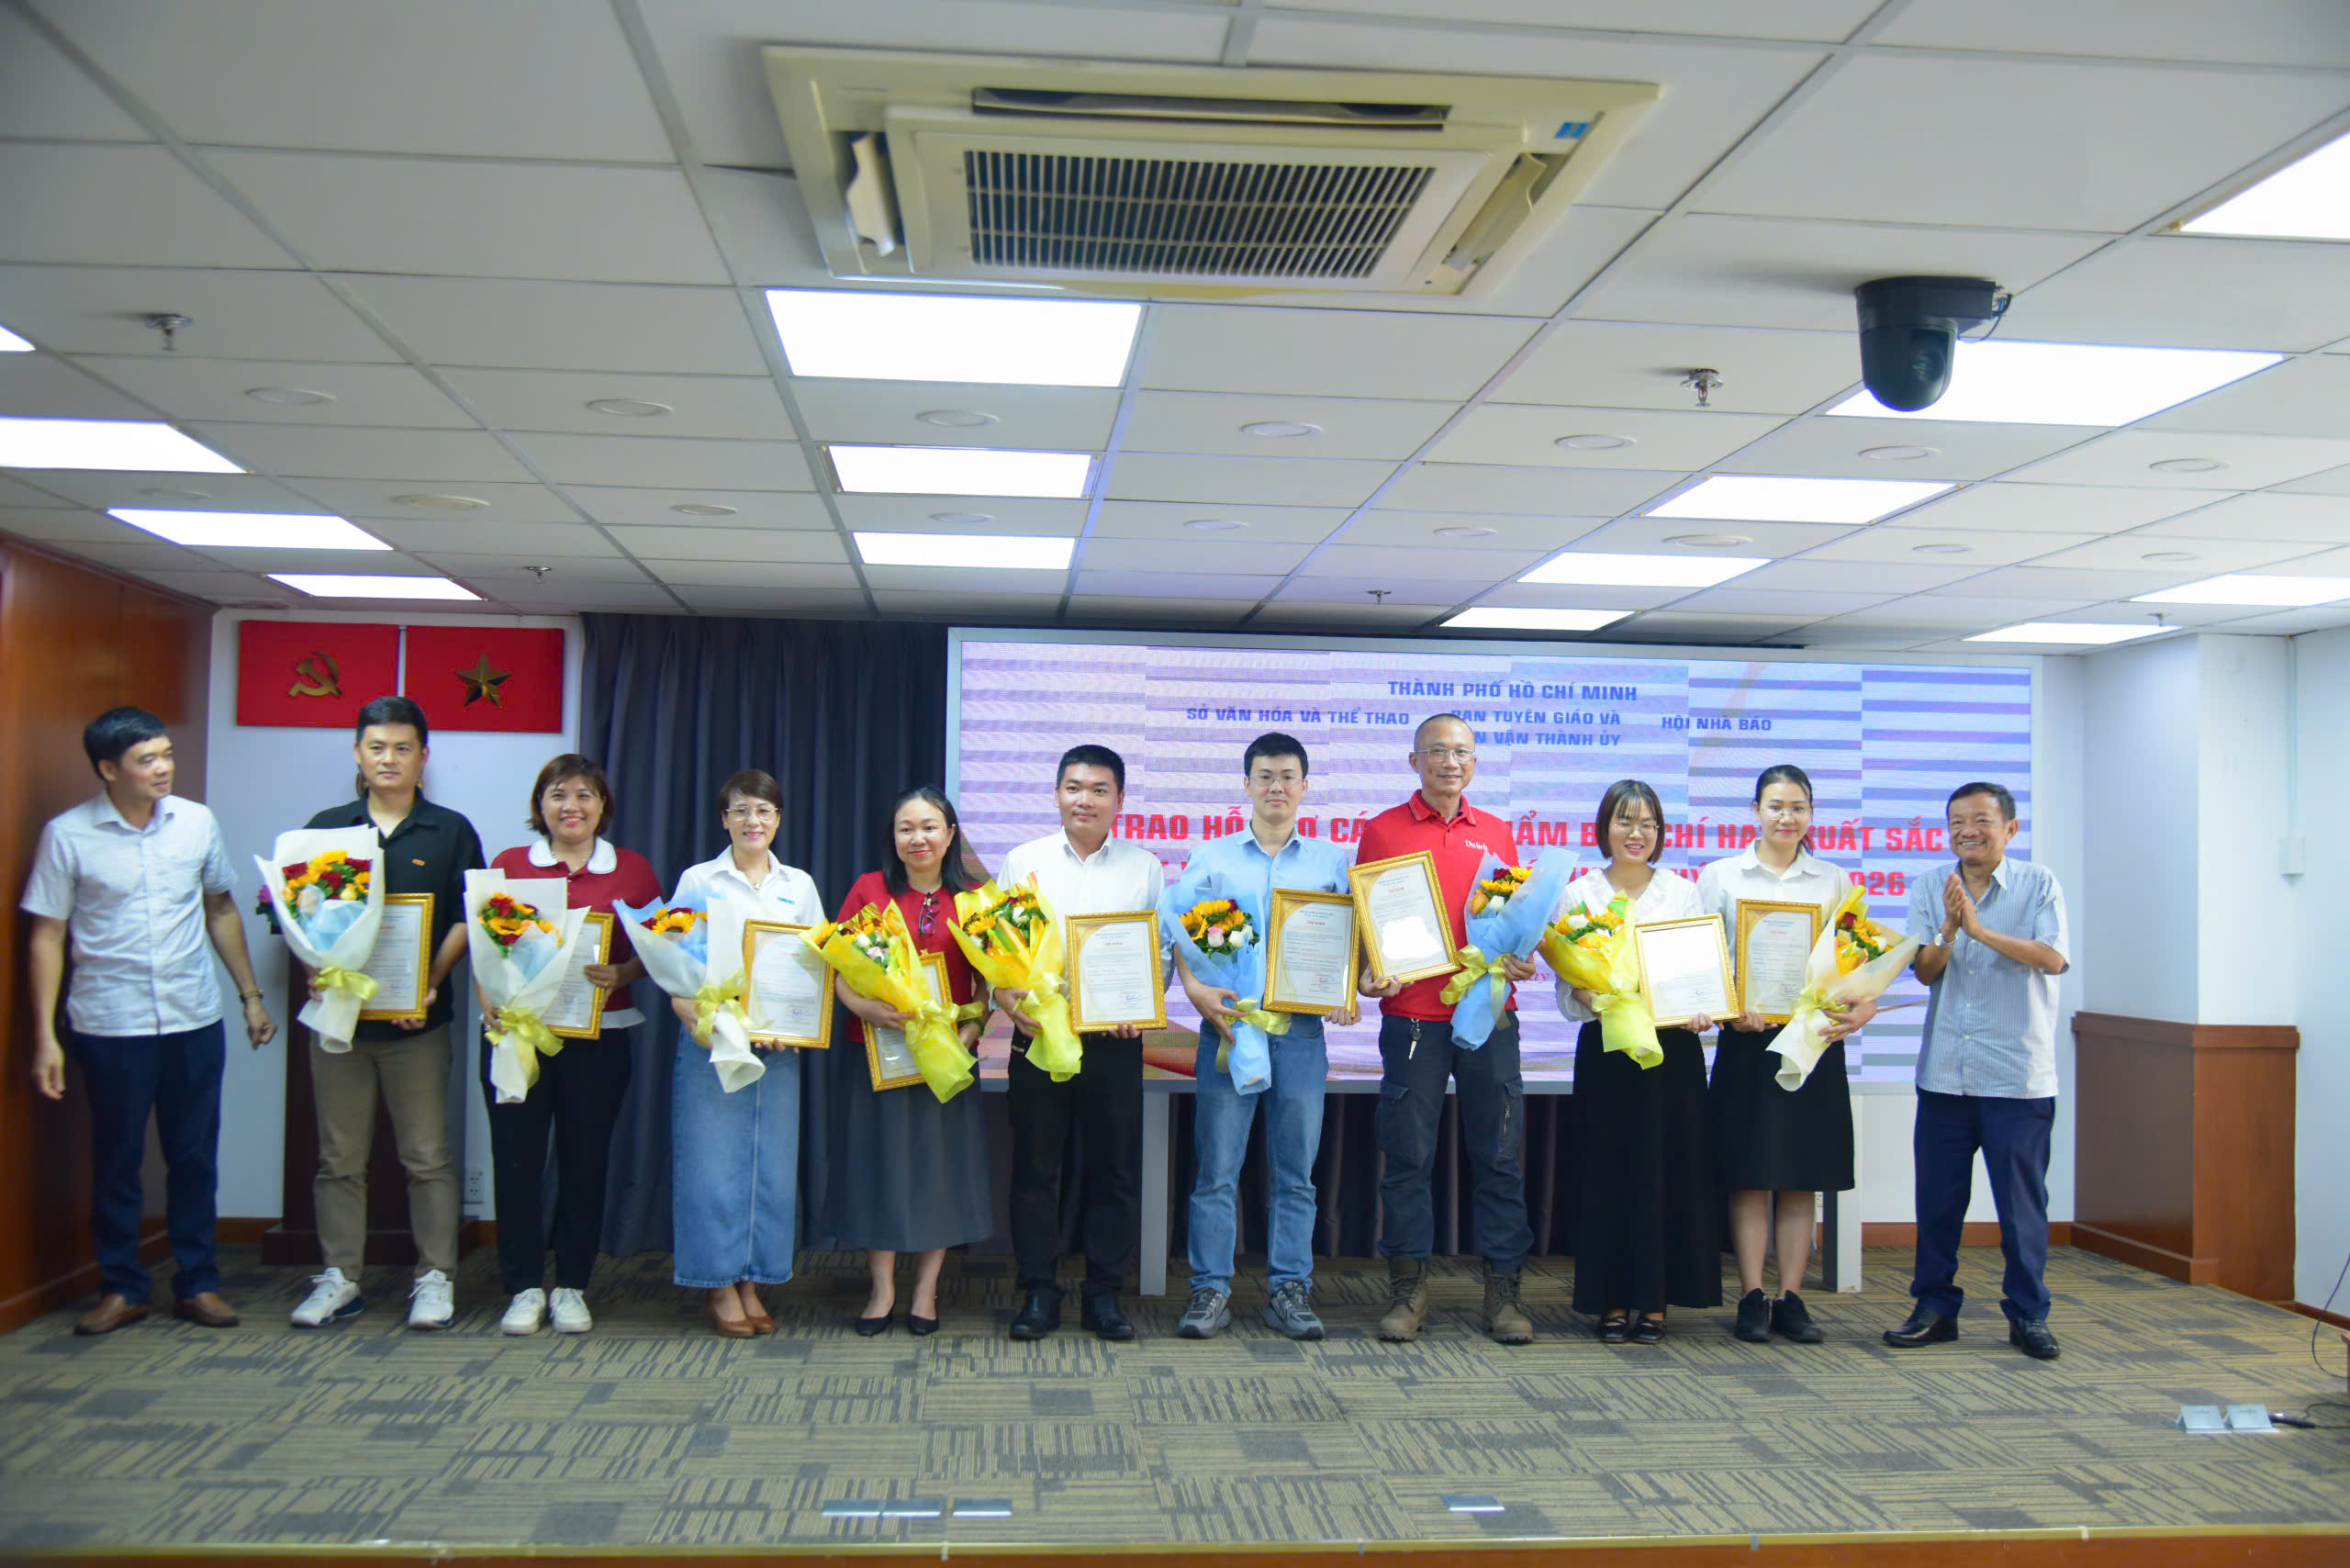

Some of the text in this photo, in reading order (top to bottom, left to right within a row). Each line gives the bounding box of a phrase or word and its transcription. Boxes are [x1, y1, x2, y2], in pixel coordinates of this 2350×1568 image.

[1387, 678, 1637, 700] THÀNH PHỐ HỒ CHÍ MINH
[1186, 703, 1410, 725] SỞ VĂN HÓA VÀ THỂ THAO
[1492, 709, 1547, 723] TUYÊN
[1553, 709, 1595, 724] GIÁO
[1599, 710, 1621, 725] VÀ
[1662, 714, 1690, 732] HỘI
[1493, 729, 1529, 746] VẬN
[1534, 730, 1594, 745] THÀNH
[1599, 729, 1621, 746] ỦY
[1110, 813, 1189, 840] TRAO
[1329, 811, 1368, 844] CÁ
[1505, 810, 1568, 846] ẨM
[1718, 823, 1762, 849] HA
[1885, 815, 1943, 853] SẮC
[1848, 870, 1905, 896] 026
